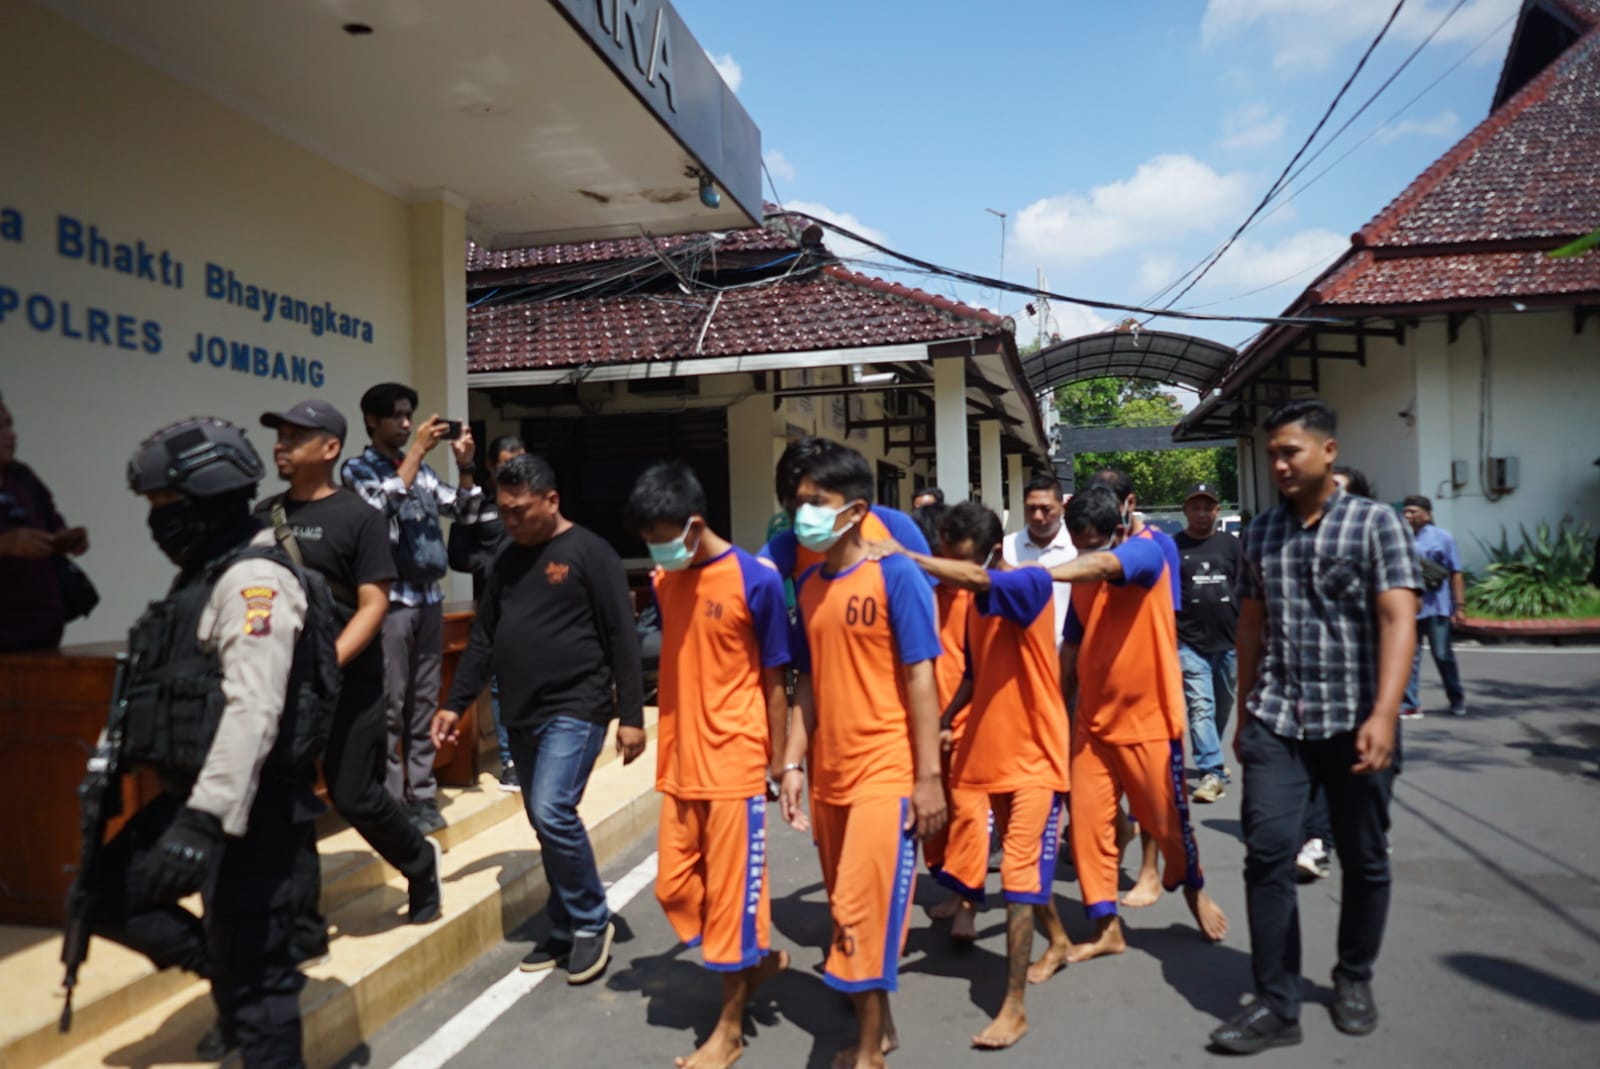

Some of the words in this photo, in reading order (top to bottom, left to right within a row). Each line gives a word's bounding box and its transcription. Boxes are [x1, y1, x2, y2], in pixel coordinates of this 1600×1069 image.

[0, 286, 164, 355] POLRES
[188, 332, 326, 389] JOMBANG
[204, 262, 374, 344] Bhayangkara
[845, 594, 877, 627] 60
